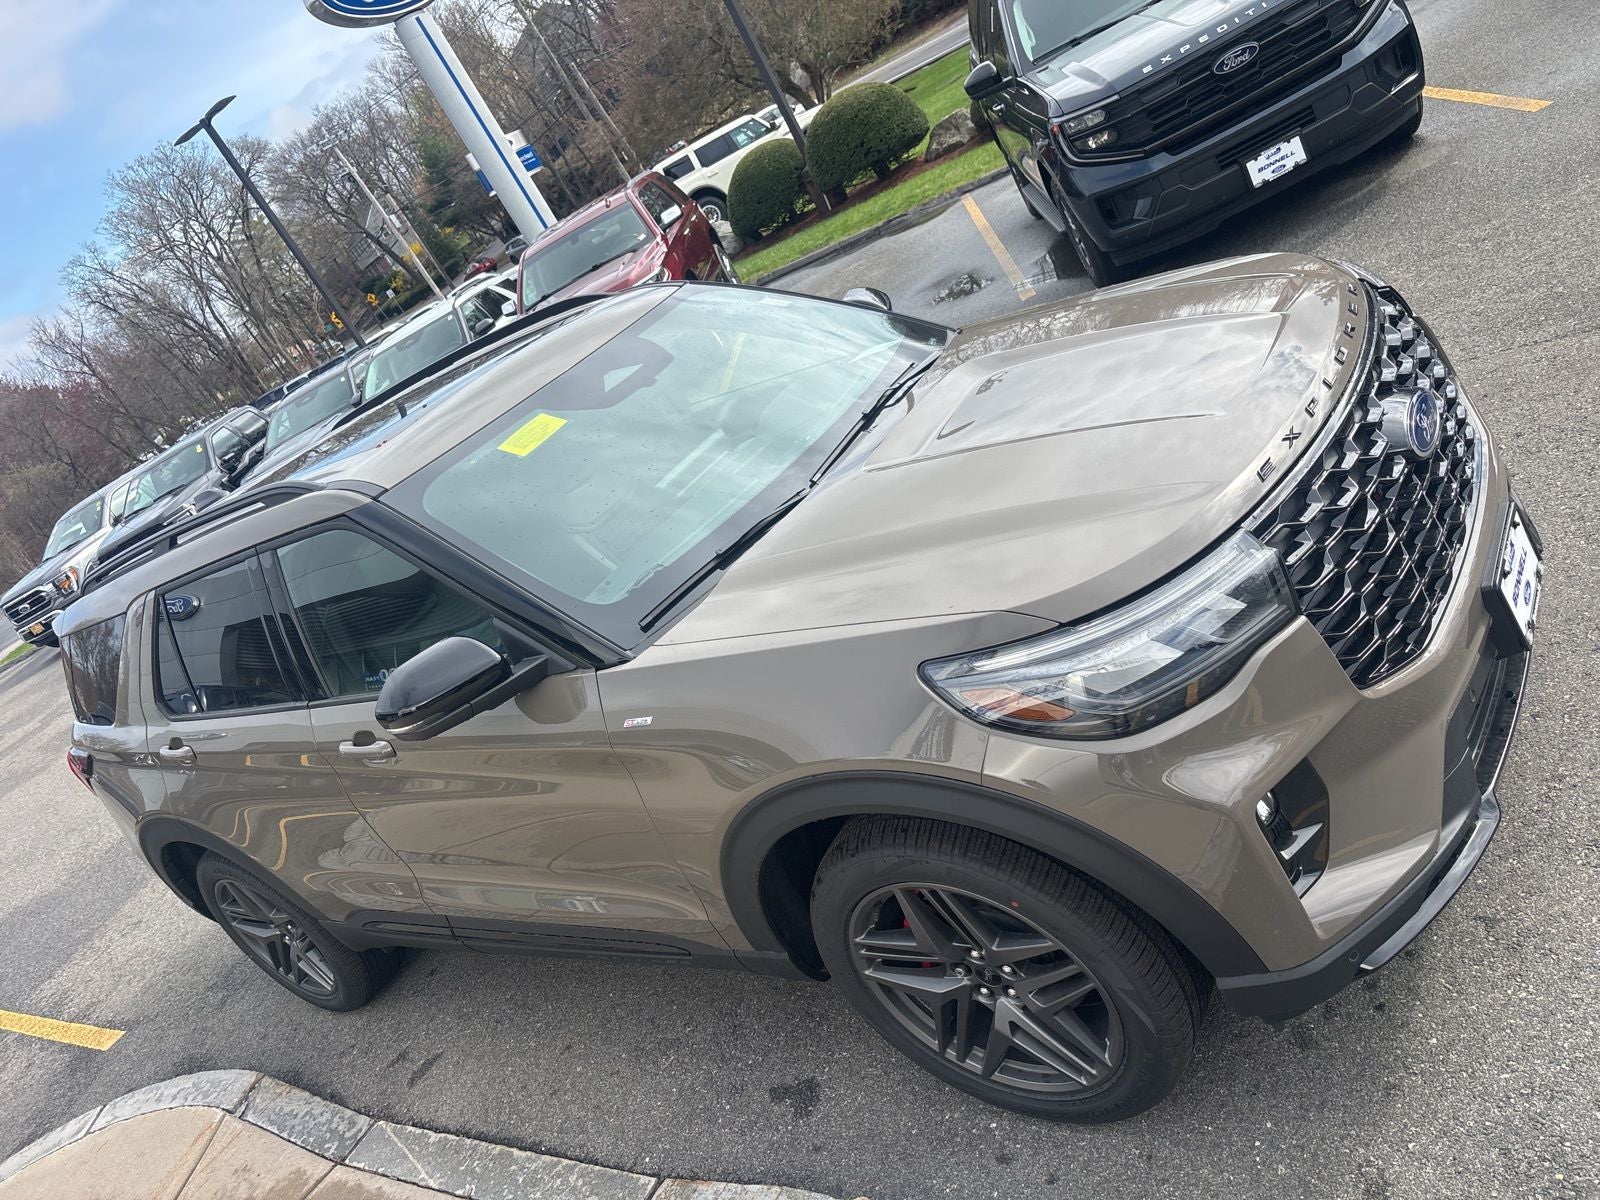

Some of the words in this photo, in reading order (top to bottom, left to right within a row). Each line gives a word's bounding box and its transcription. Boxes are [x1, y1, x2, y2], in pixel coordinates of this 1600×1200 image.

[1142, 1, 1267, 74] EXPEDITI
[1223, 48, 1251, 71] Ford
[1257, 150, 1296, 174] BONNELL
[1256, 283, 1359, 484] EXPLORER
